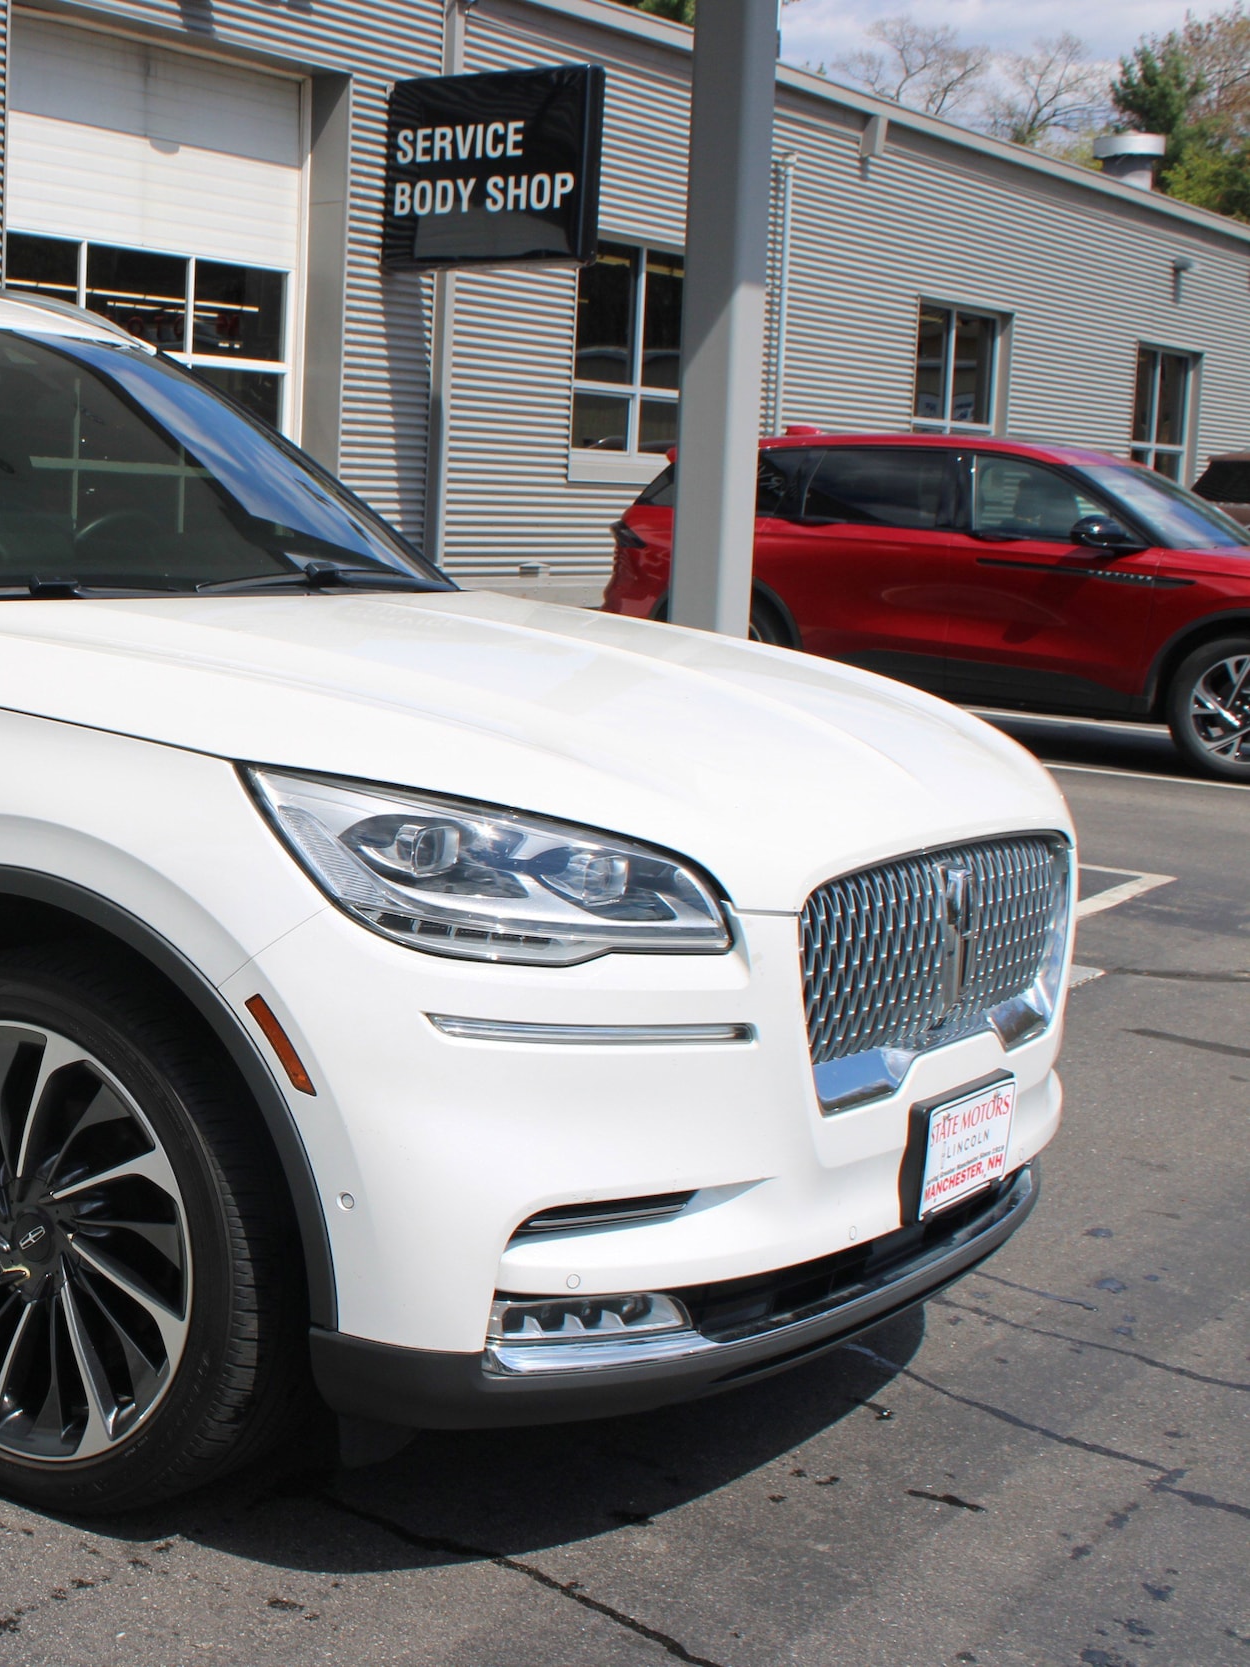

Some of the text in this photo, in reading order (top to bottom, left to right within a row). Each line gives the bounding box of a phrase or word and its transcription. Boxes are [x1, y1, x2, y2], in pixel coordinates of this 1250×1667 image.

[396, 121, 525, 164] SERVICE
[394, 172, 575, 216] BODY SHOP
[930, 1094, 1011, 1147] STATE MOTORS
[947, 1130, 990, 1158] LINCOLN
[988, 1153, 1003, 1170] NH
